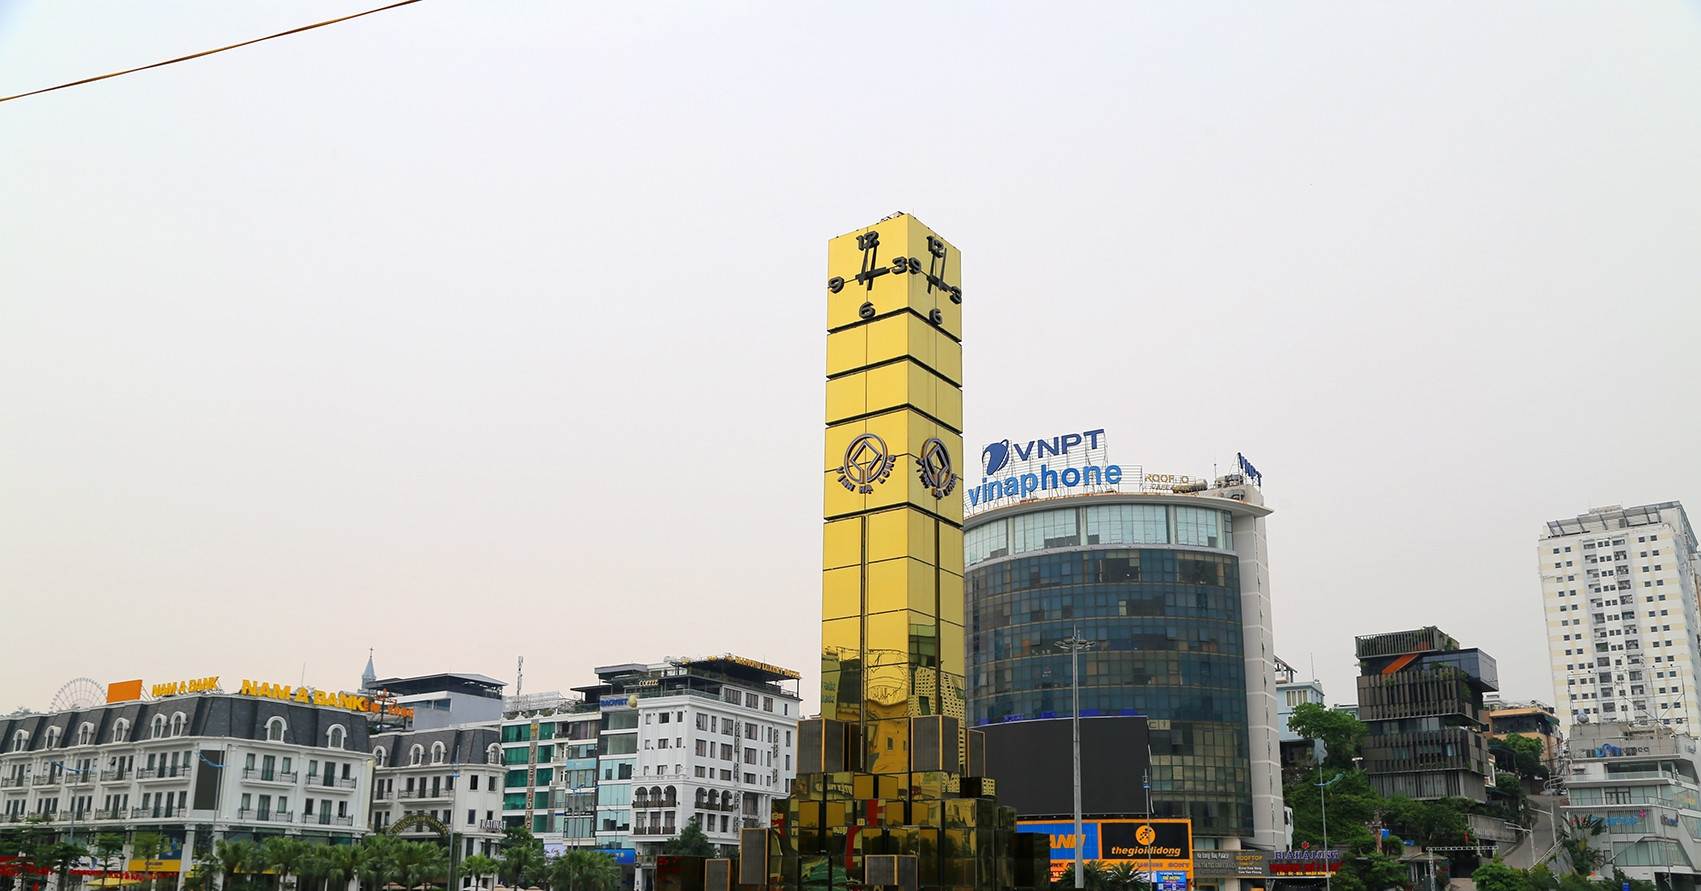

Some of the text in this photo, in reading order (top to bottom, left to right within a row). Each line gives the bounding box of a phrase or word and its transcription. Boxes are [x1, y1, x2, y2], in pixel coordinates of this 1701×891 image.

[856, 231, 880, 251] 12
[926, 235, 945, 258] 12
[828, 256, 908, 294] 9 3
[908, 257, 962, 305] 9 3
[859, 302, 876, 319] 6
[929, 308, 943, 325] 6
[1013, 428, 1104, 461] VNPT
[877, 454, 896, 484] LONG
[968, 464, 1122, 507] vinaphone
[151, 681, 177, 697] NAM
[188, 676, 219, 692] BANK
[241, 679, 365, 712] NAM A BANK
[1111, 846, 1182, 857] thegioididong
